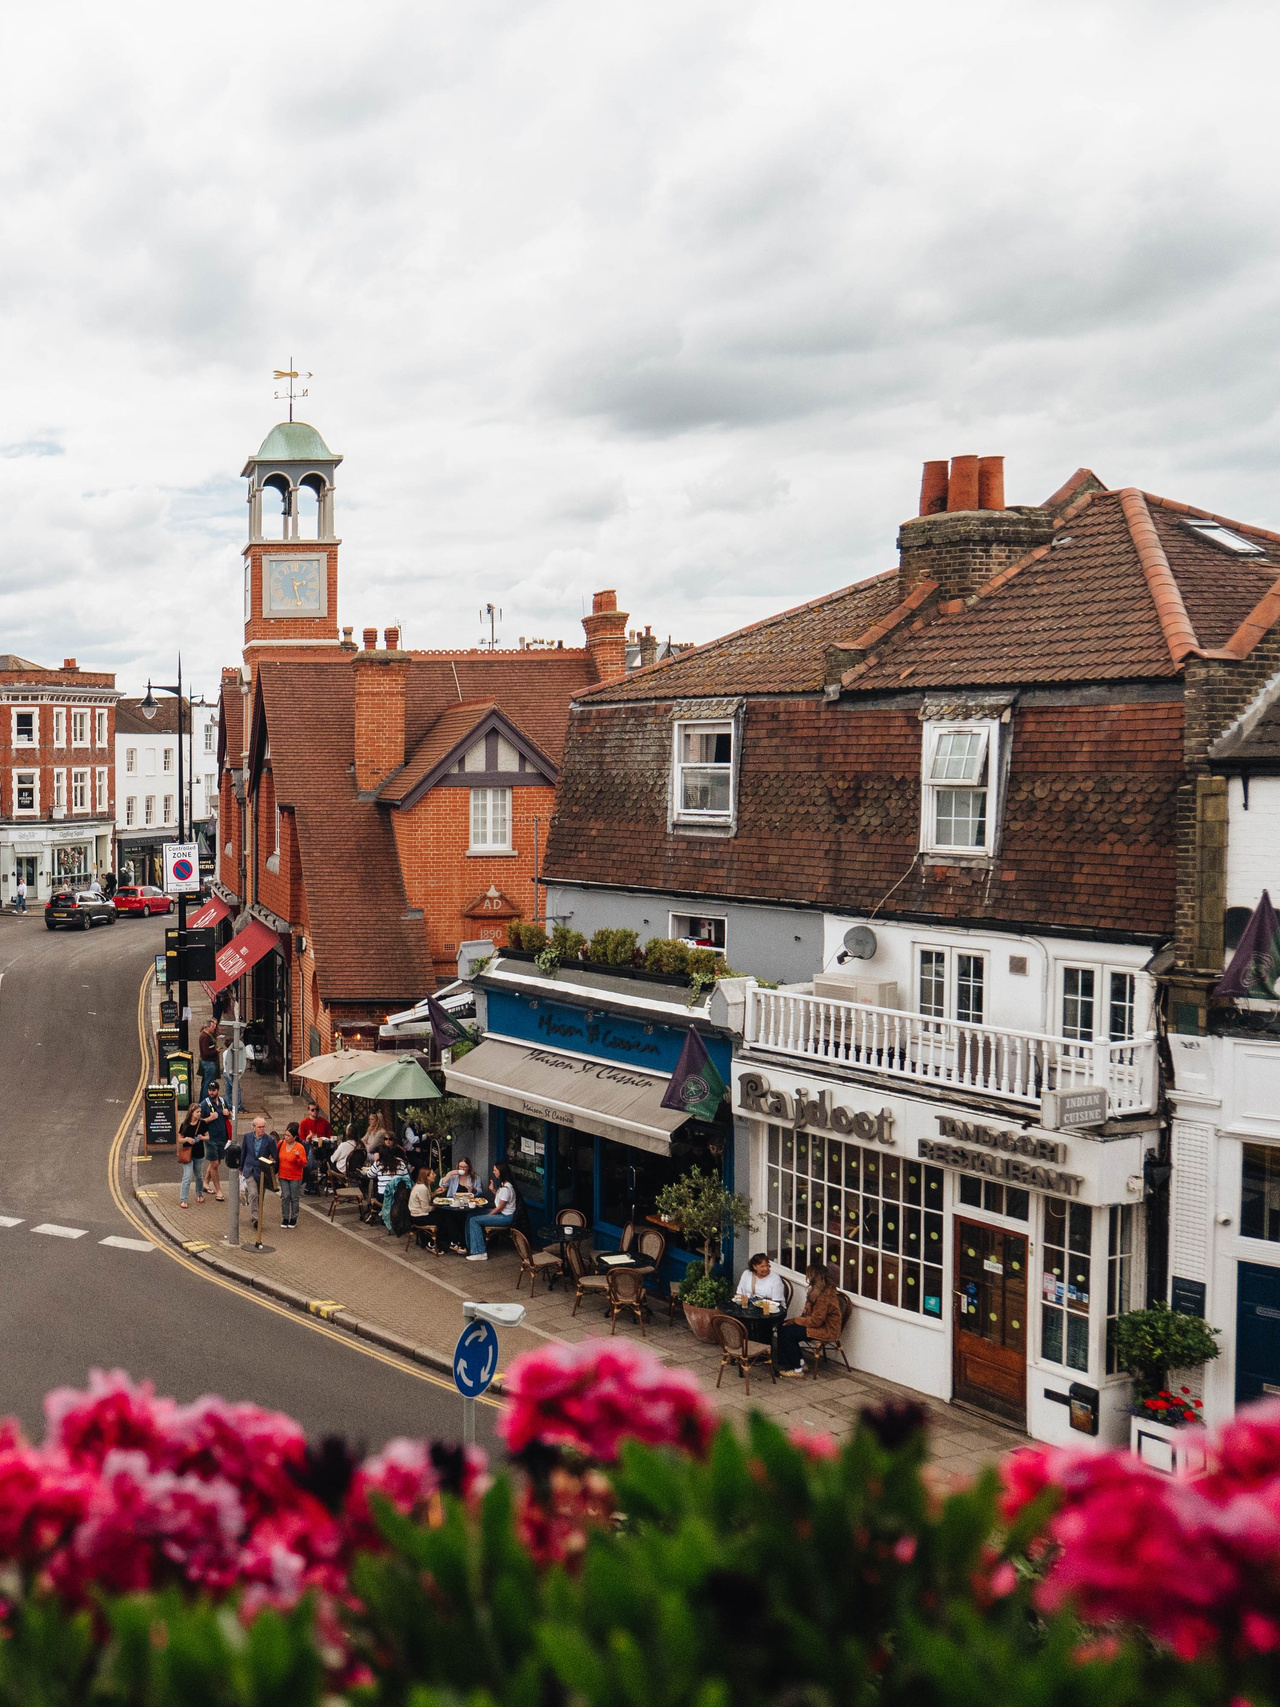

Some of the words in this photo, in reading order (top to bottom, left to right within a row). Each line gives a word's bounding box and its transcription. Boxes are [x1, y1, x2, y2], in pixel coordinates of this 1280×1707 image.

[480, 929, 503, 940] 1890
[538, 1014, 583, 1037] Maison
[522, 1050, 575, 1071] Maison
[575, 1063, 595, 1074] St
[522, 1101, 544, 1116] Maison
[552, 1110, 574, 1124] Cassien
[737, 1072, 897, 1145] Rajdoot
[1065, 1094, 1100, 1109] INDIAN
[1063, 1109, 1102, 1124] CUISINE
[934, 1115, 1068, 1165] TANDOORI
[918, 1138, 1085, 1197] RESTAURANT
